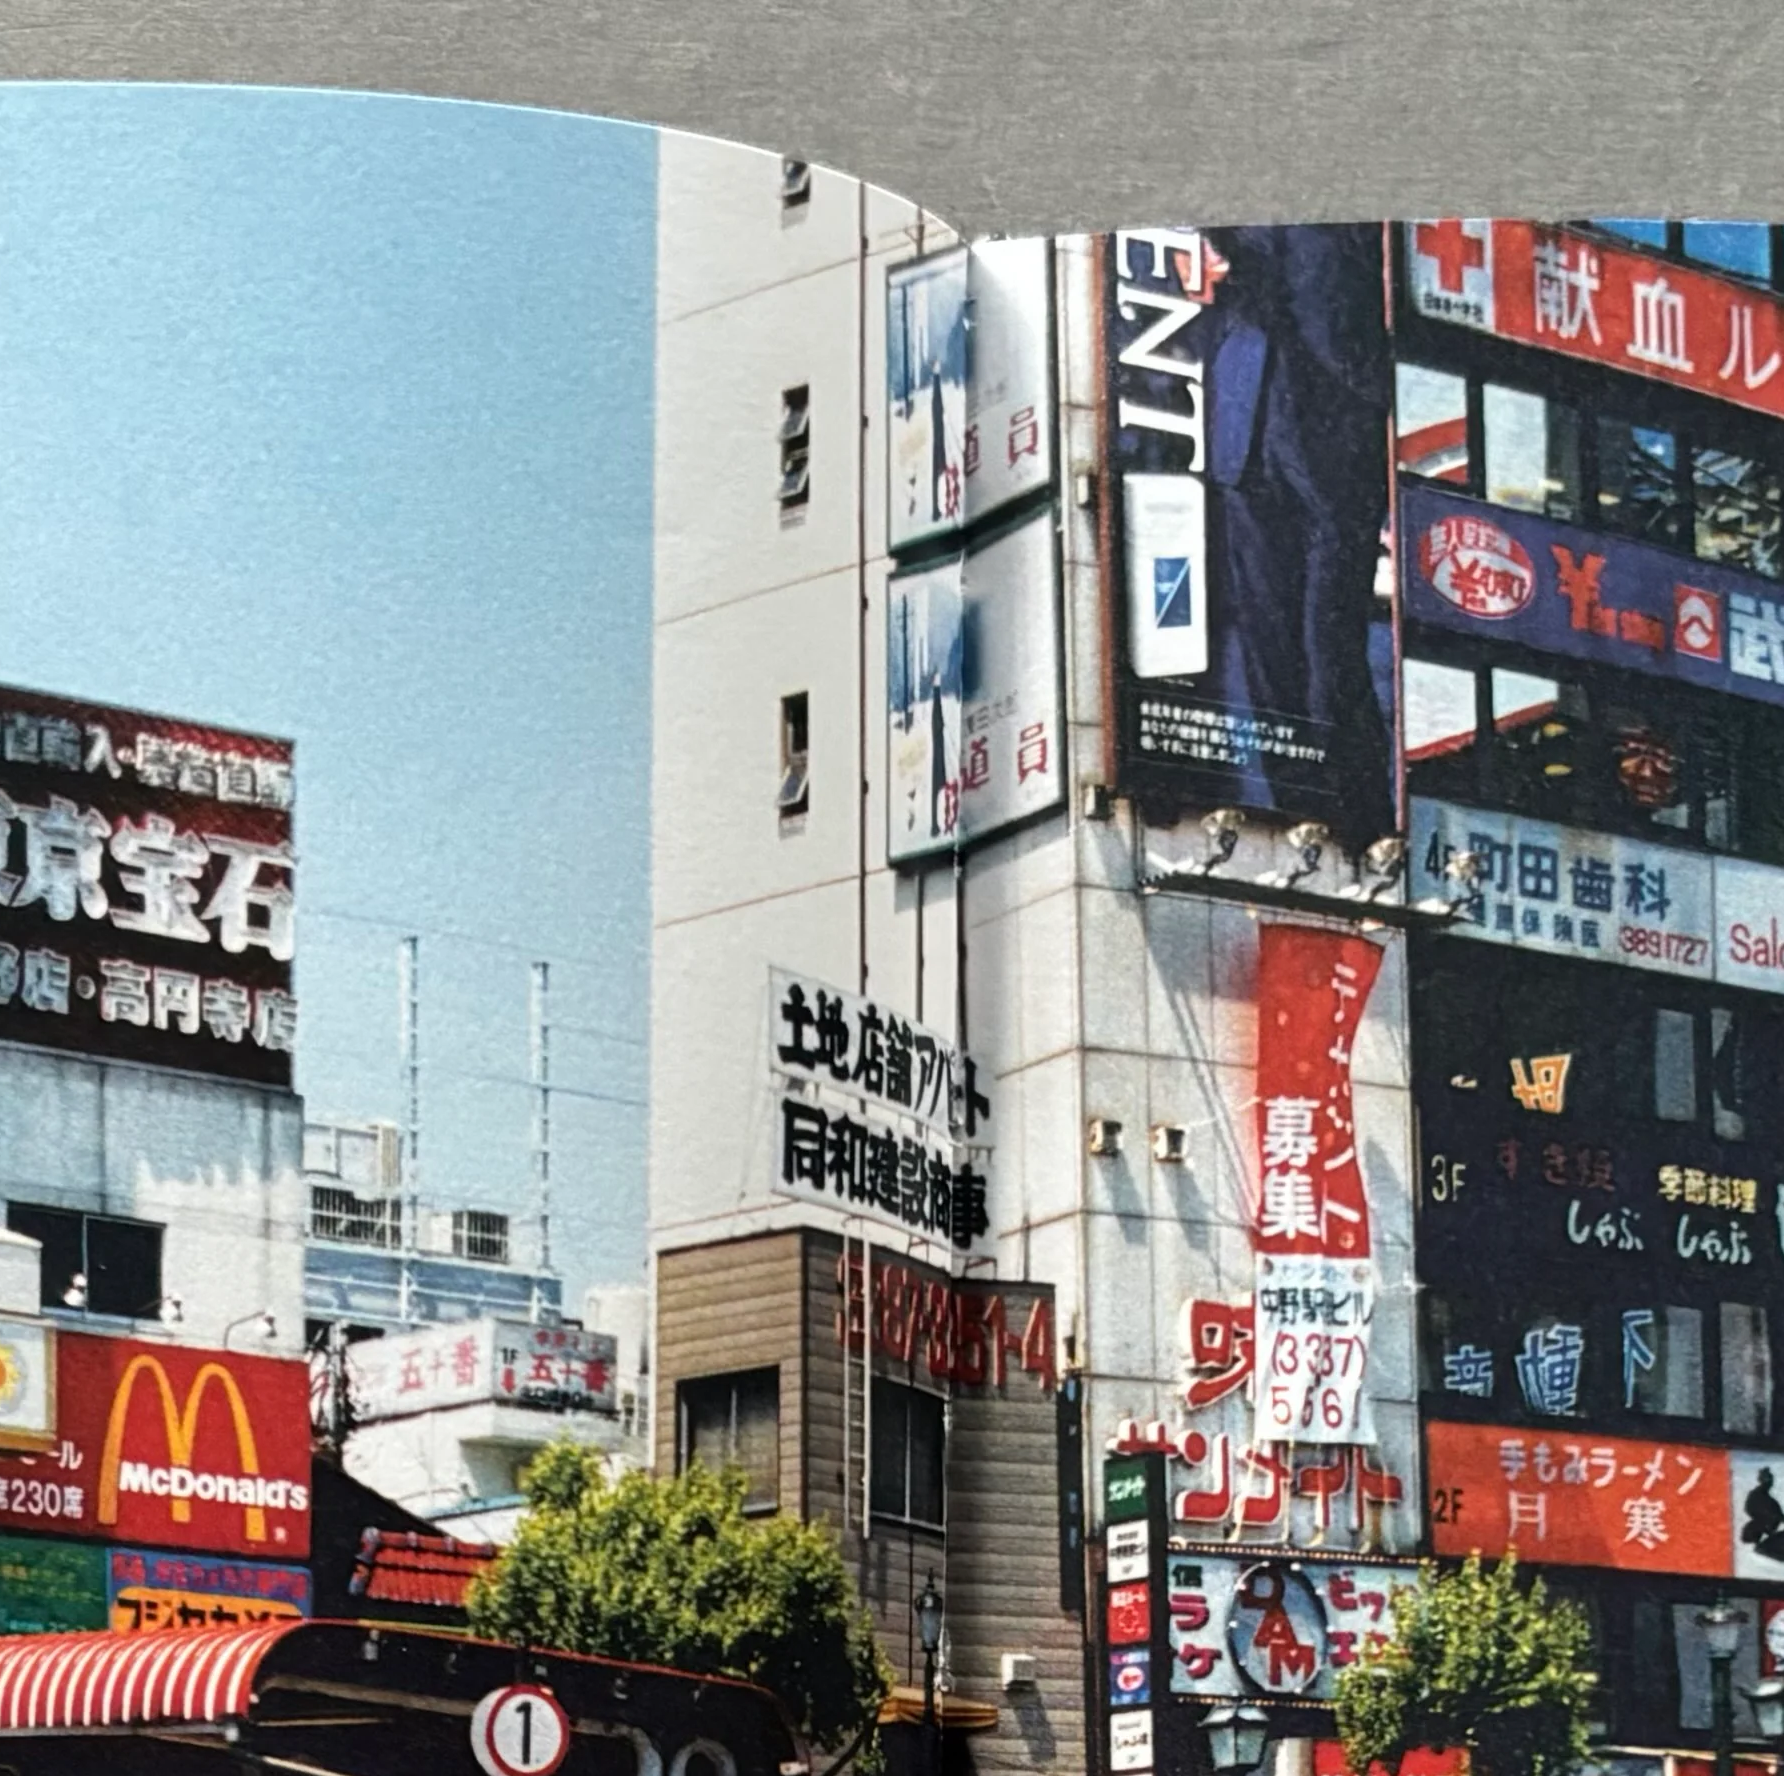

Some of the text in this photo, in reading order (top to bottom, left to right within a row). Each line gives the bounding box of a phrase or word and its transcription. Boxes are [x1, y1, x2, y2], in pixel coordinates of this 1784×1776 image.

[1469, 831, 1672, 921] 町田歯科
[1259, 1093, 1322, 1241] 募集
[1430, 1154, 1467, 1202] 3F
[120, 1461, 309, 1511] McDonald's
[1497, 1438, 1705, 1497] 手もみラーメン
[1433, 1488, 1464, 1527] 2F
[515, 1701, 533, 1766] 1
